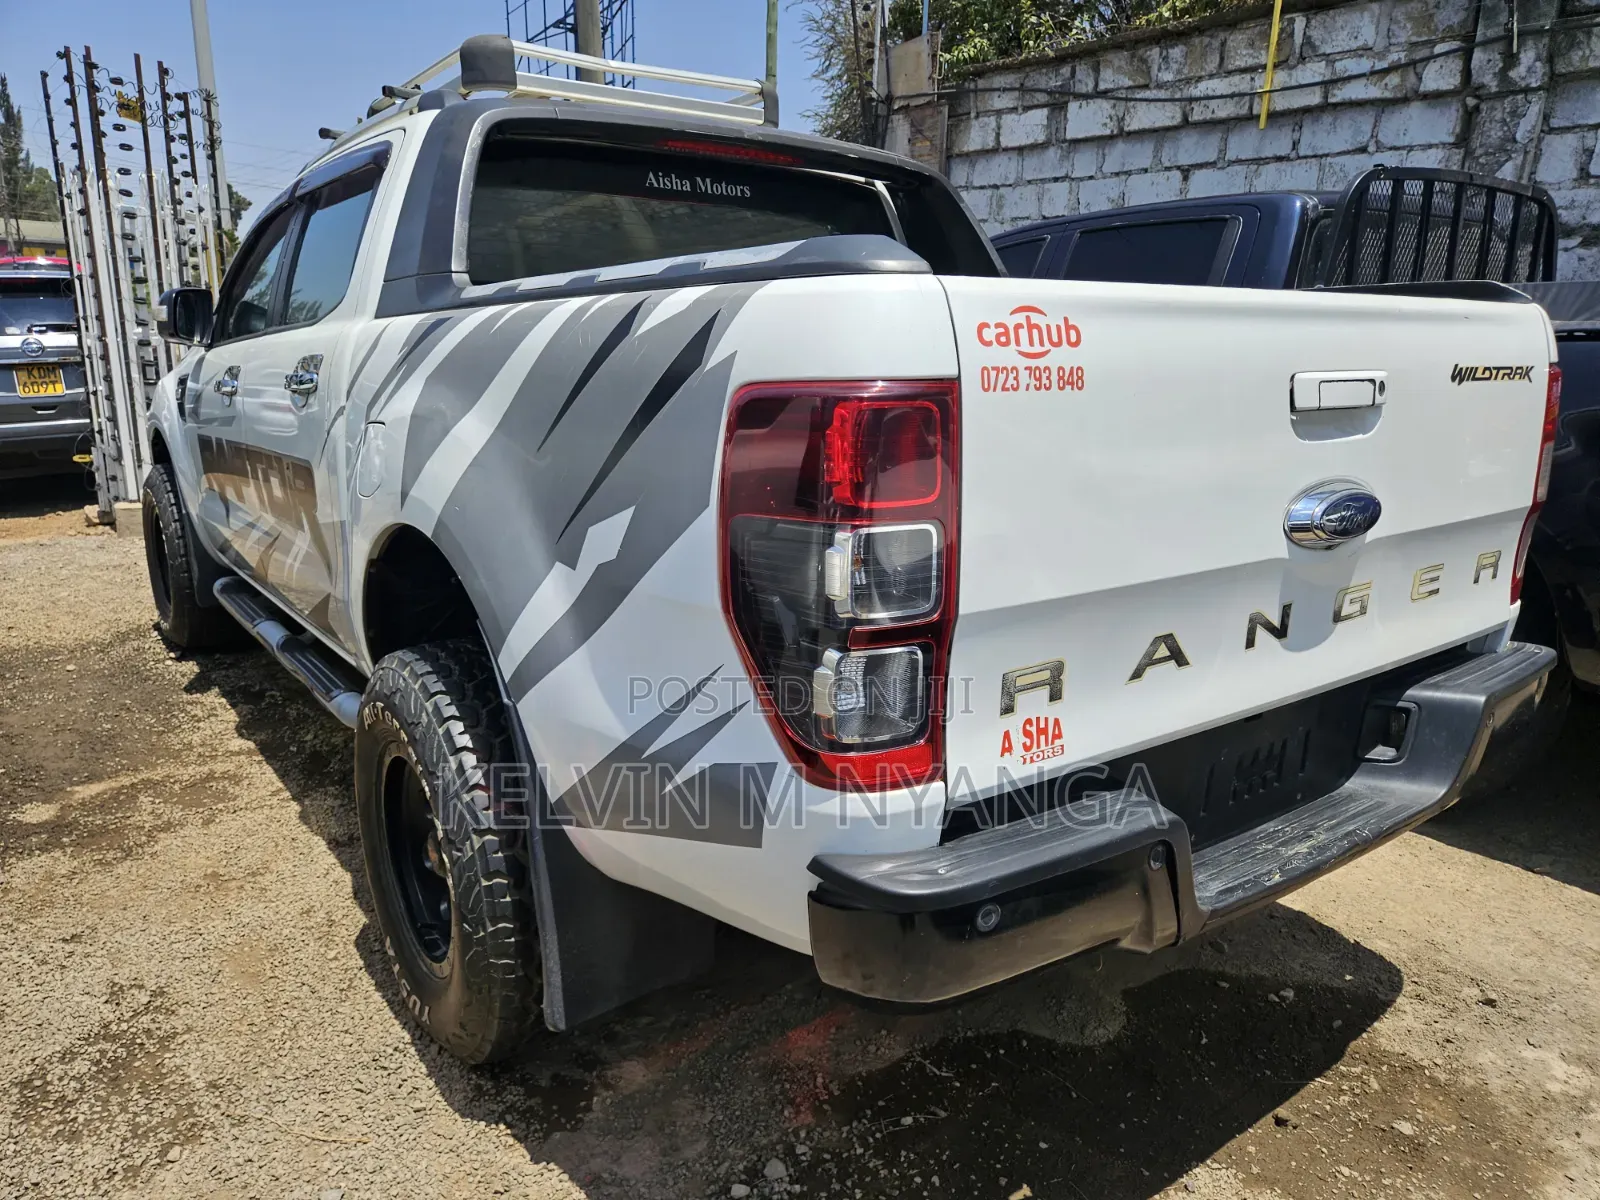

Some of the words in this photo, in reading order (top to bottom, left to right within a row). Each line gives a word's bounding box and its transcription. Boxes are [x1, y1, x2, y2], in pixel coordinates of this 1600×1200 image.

[645, 171, 691, 192] Aisha
[694, 176, 751, 198] Motors
[976, 314, 1082, 348] carhub
[26, 366, 58, 380] KDM
[980, 365, 1020, 393] 0723
[1023, 365, 1053, 392] 793
[1056, 365, 1085, 392] 848
[1450, 363, 1535, 387] WILDTRAK
[22, 380, 58, 394] 609T
[998, 549, 1503, 720] RANGER
